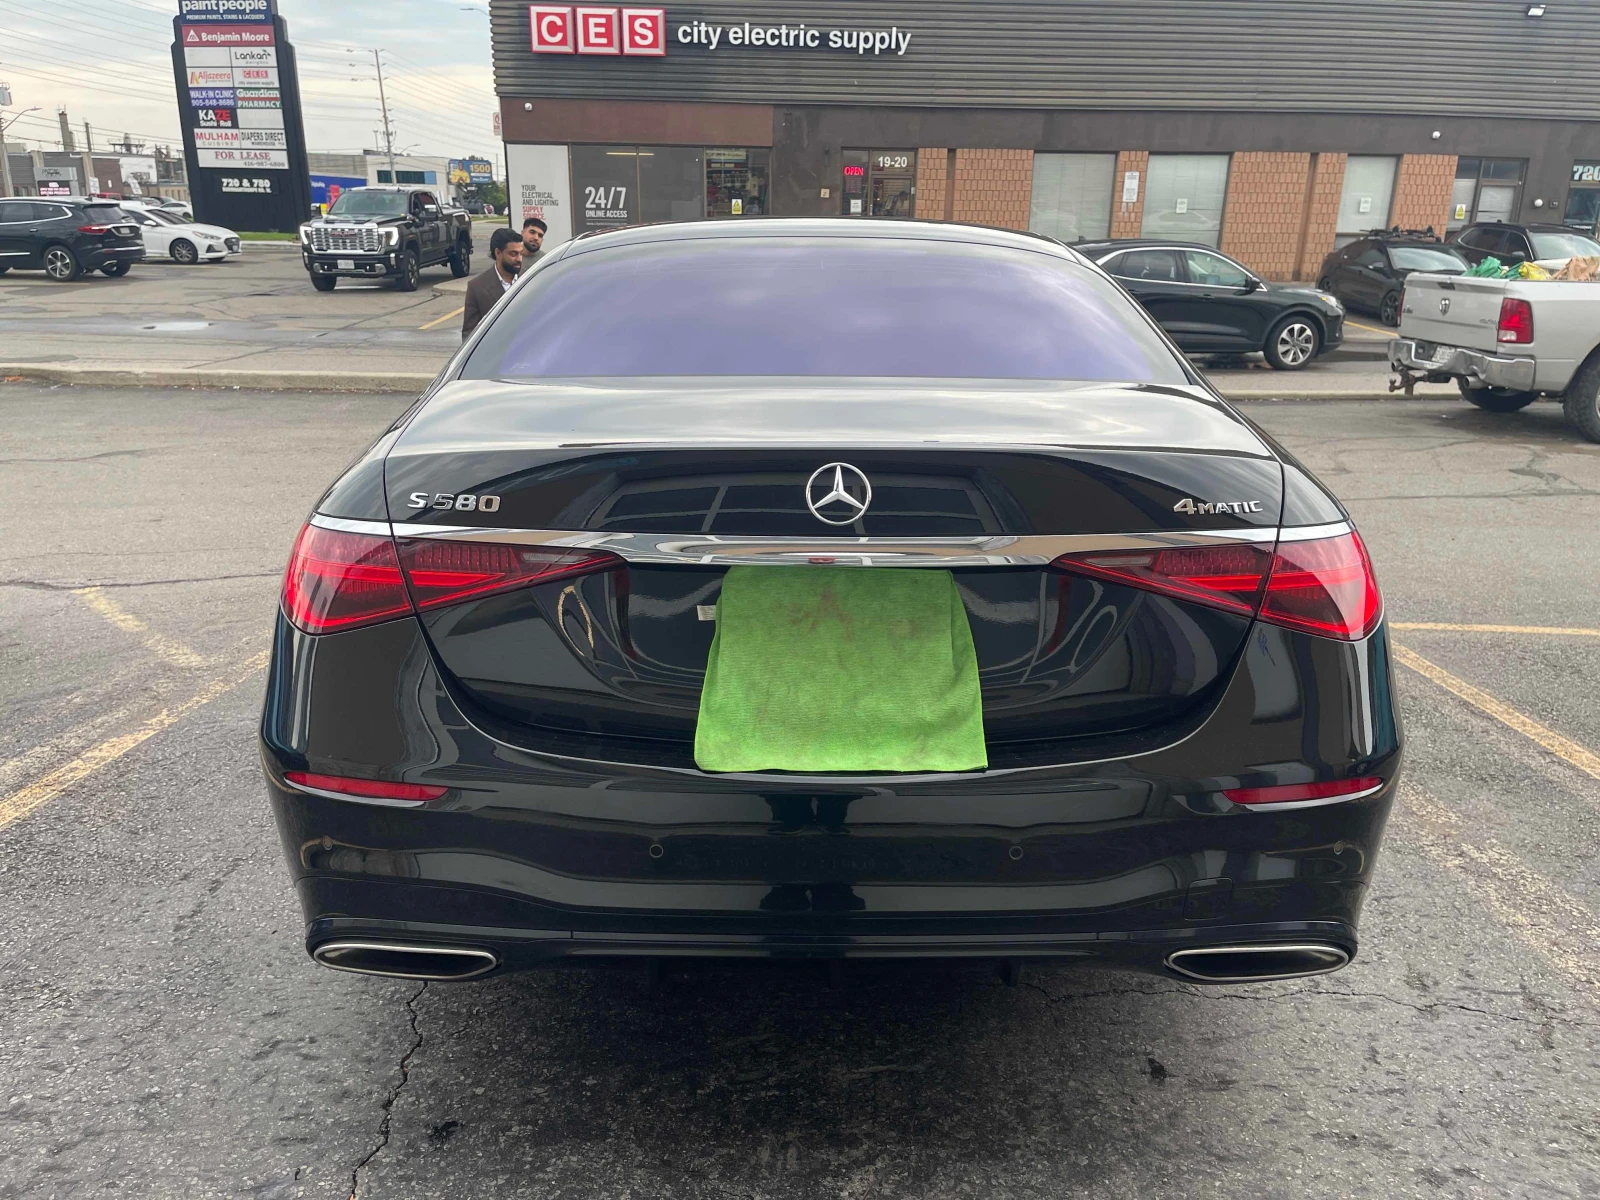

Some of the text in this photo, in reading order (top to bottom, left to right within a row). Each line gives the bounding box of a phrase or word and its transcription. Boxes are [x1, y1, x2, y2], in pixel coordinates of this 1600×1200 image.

[182, 0, 267, 13] paint people
[539, 14, 655, 47] CES
[201, 32, 270, 43] Benjamin Moore
[677, 21, 911, 55] city electric supply
[234, 51, 268, 60] Lankan
[189, 90, 234, 98] WALK-IN CLINIC
[236, 89, 280, 97] Guardian
[198, 110, 231, 120] KAZE
[195, 132, 238, 141] MULHAM
[241, 132, 284, 141] DIAPERS DIRECT
[215, 151, 235, 160] FOR
[878, 156, 908, 168] 19-20
[843, 166, 864, 176] OPEN
[221, 178, 240, 187] 720
[521, 191, 554, 199] ELECTRICAL
[585, 186, 627, 209] 24/7
[585, 210, 628, 218] ONLINE ACCESS
[407, 491, 429, 510] S
[1173, 498, 1264, 516] 4MATIC
